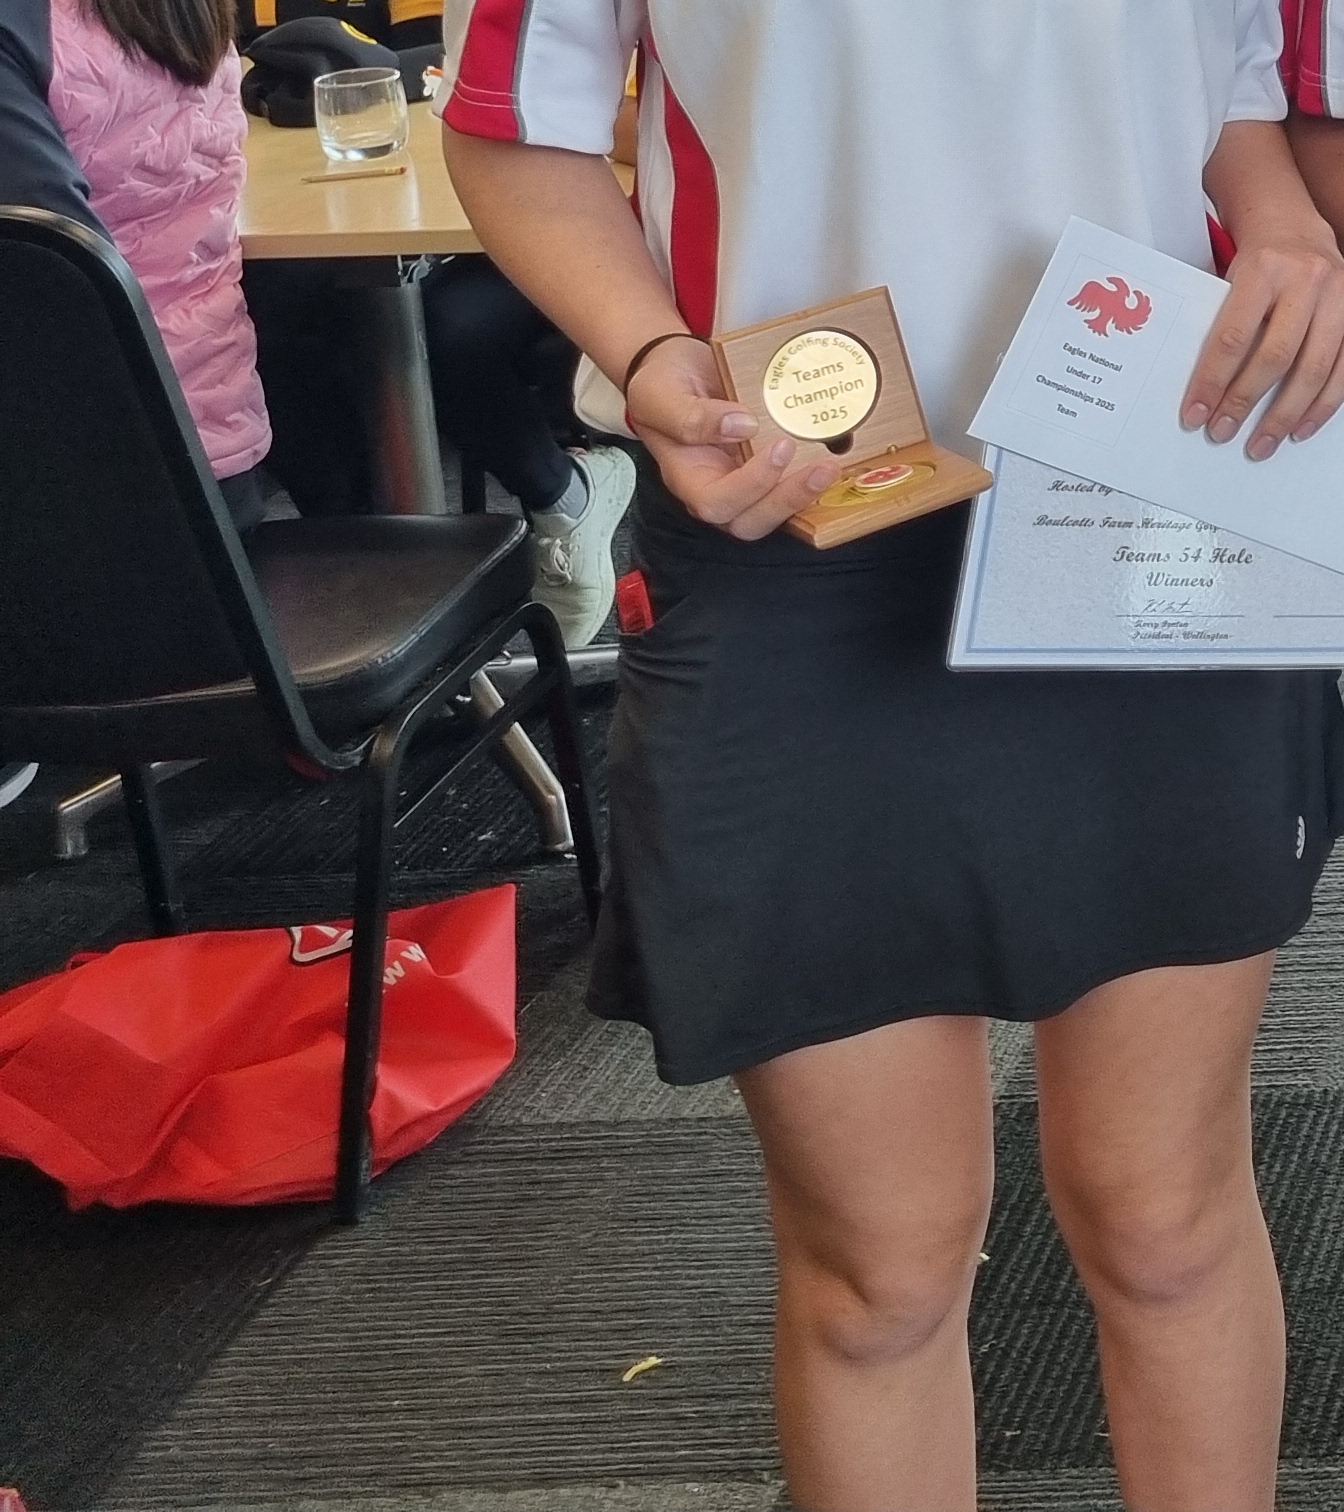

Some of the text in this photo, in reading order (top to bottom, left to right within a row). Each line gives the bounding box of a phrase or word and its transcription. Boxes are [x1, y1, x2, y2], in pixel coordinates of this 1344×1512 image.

[769, 337, 866, 390] Eagles Golfing Society
[1062, 342, 1124, 372] Eagles National
[791, 362, 845, 383] Teams
[1066, 365, 1103, 385] Under 17
[783, 378, 865, 409] Champion
[1036, 374, 1116, 412] Championships 2025
[811, 405, 849, 425] 2025
[1056, 403, 1078, 418] Team
[1047, 479, 1094, 492] Hosted
[1032, 514, 1095, 529] Boulcotts
[1098, 516, 1134, 529] Farm
[1137, 517, 1193, 531] Heritage
[1112, 546, 1254, 564] Teams 54 Hole
[1146, 571, 1214, 588] Winners
[1181, 630, 1230, 641] Wellington
